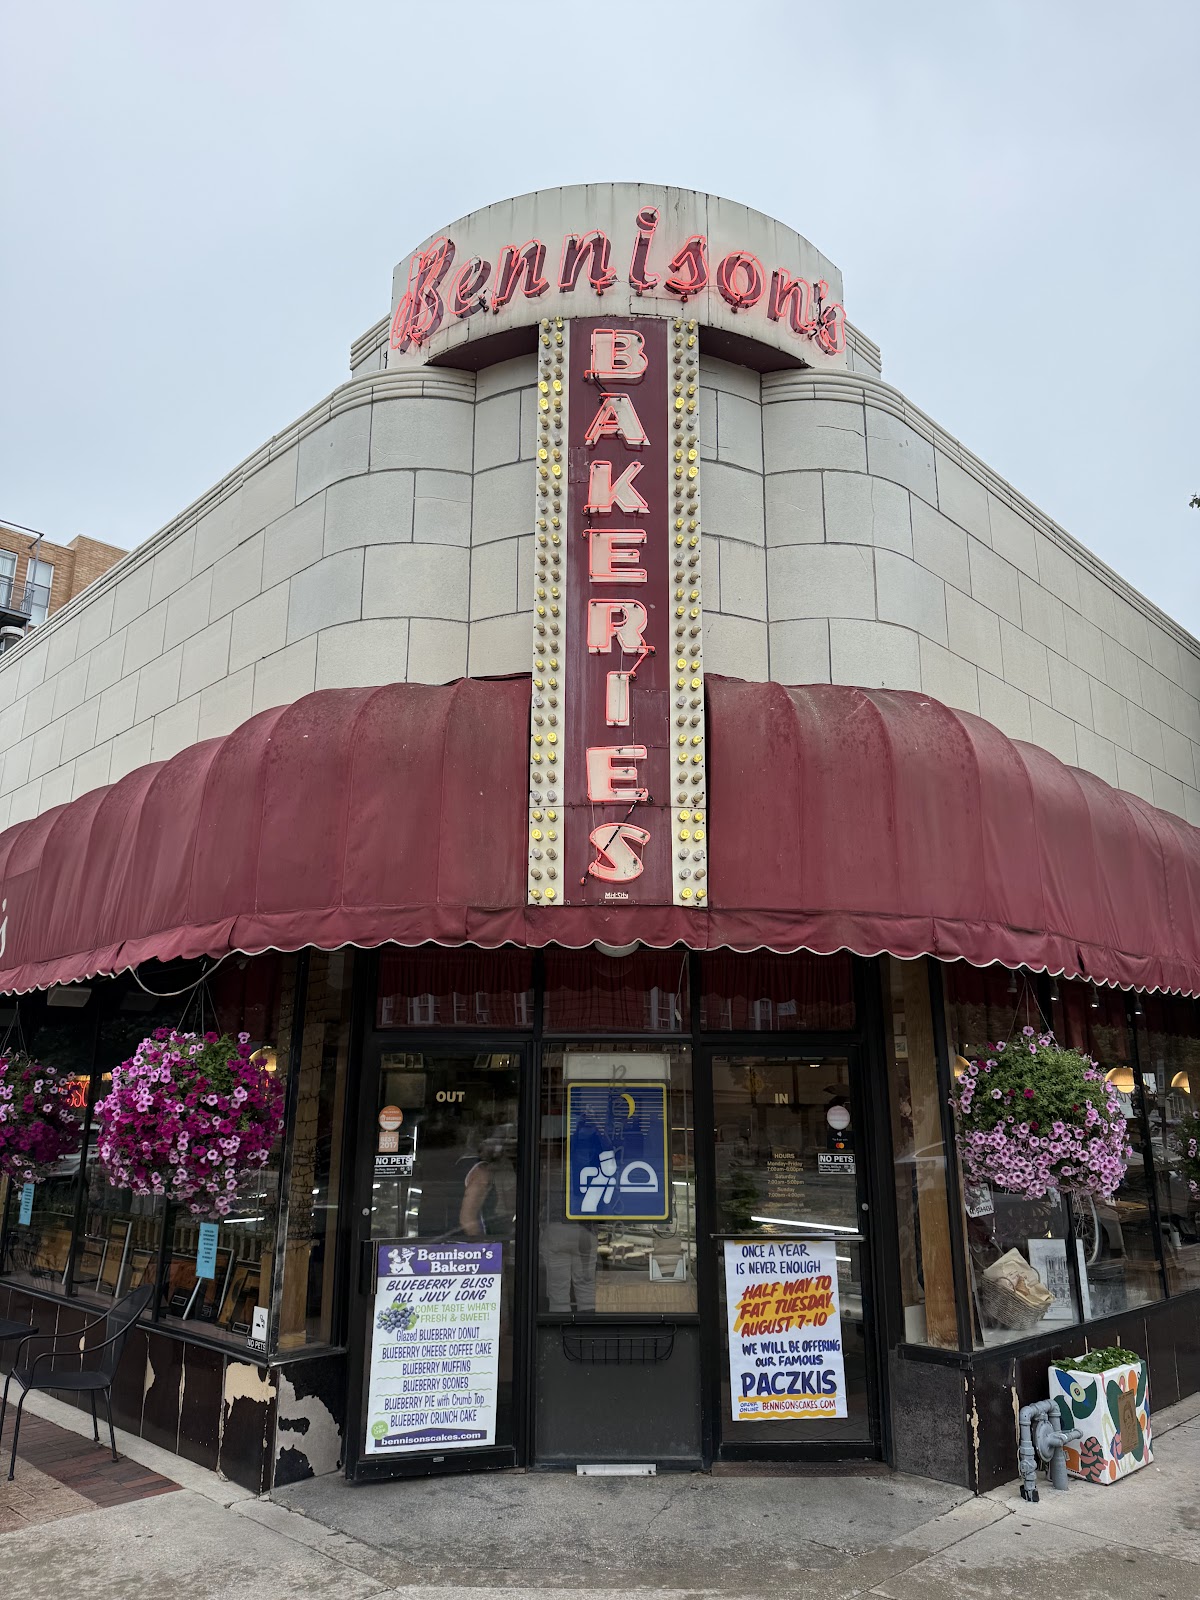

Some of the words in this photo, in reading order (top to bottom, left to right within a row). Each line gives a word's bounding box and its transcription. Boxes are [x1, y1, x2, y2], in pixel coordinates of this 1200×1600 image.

[583, 328, 652, 882] BAKERIES
[436, 1091, 465, 1103] OUT
[776, 1094, 788, 1104] IN
[375, 1157, 388, 1165] NO
[390, 1156, 411, 1164] PETS
[834, 1155, 853, 1163] PETS
[417, 1248, 493, 1261] Bennison's
[742, 1245, 765, 1257] ONCE
[769, 1245, 776, 1256] A
[778, 1244, 810, 1256] YEAR
[430, 1262, 480, 1274] Bakery
[736, 1263, 745, 1274] IS
[749, 1262, 777, 1274] NEVER
[780, 1260, 821, 1274] ENOUGH
[386, 1278, 456, 1291] BLUEBERRY
[460, 1277, 495, 1288] BLISS
[742, 1282, 781, 1300] HALF
[784, 1277, 813, 1296] WAY
[816, 1275, 832, 1291] TO
[393, 1293, 413, 1303] ALL
[419, 1291, 451, 1302] JULY
[455, 1289, 487, 1300] LONG
[415, 1304, 439, 1313] COME
[441, 1303, 465, 1312] TASTE
[467, 1302, 497, 1311] WHAT'S
[740, 1301, 772, 1320] FAT
[775, 1292, 834, 1315] TUESDAY
[420, 1314, 448, 1323] FRESH
[450, 1313, 458, 1322] &
[460, 1312, 490, 1322] SWEET!
[741, 1317, 794, 1338] AUGUST
[798, 1312, 828, 1329] 7-10
[396, 1329, 418, 1342] Glazed
[419, 1328, 456, 1340] BLUEBERRY
[458, 1327, 480, 1339] DONUT
[247, 1339, 254, 1347] NO
[255, 1341, 266, 1350] PETS
[382, 1346, 420, 1359] BLUEBERRY
[422, 1344, 447, 1357] CHEESE
[449, 1344, 474, 1356] COFFEE
[475, 1342, 492, 1354] CAKE
[742, 1343, 757, 1355] WE
[761, 1341, 787, 1354] WILL
[788, 1340, 800, 1352] BE
[802, 1339, 841, 1352] OFFERING
[755, 1358, 776, 1367] OUR
[778, 1354, 824, 1366] FAMOUS
[402, 1362, 440, 1376] BLUEBERRY
[441, 1360, 471, 1373] MUFFINS
[403, 1378, 440, 1392] BLUEBERRY
[442, 1377, 469, 1389] SCONES
[740, 1370, 837, 1397] PACZKIS
[384, 1396, 422, 1411] BLUEBERRY
[424, 1395, 435, 1407] PIE
[436, 1395, 450, 1407] with
[452, 1394, 472, 1406] Crumb
[474, 1393, 485, 1406] Top
[762, 1400, 836, 1410] BENNISONSCAKES.COM
[390, 1413, 429, 1428] BLUEBERRY
[430, 1411, 458, 1425] CRUNCH
[459, 1409, 477, 1422] CAKE
[381, 1431, 481, 1446] bennisonscakes.com
